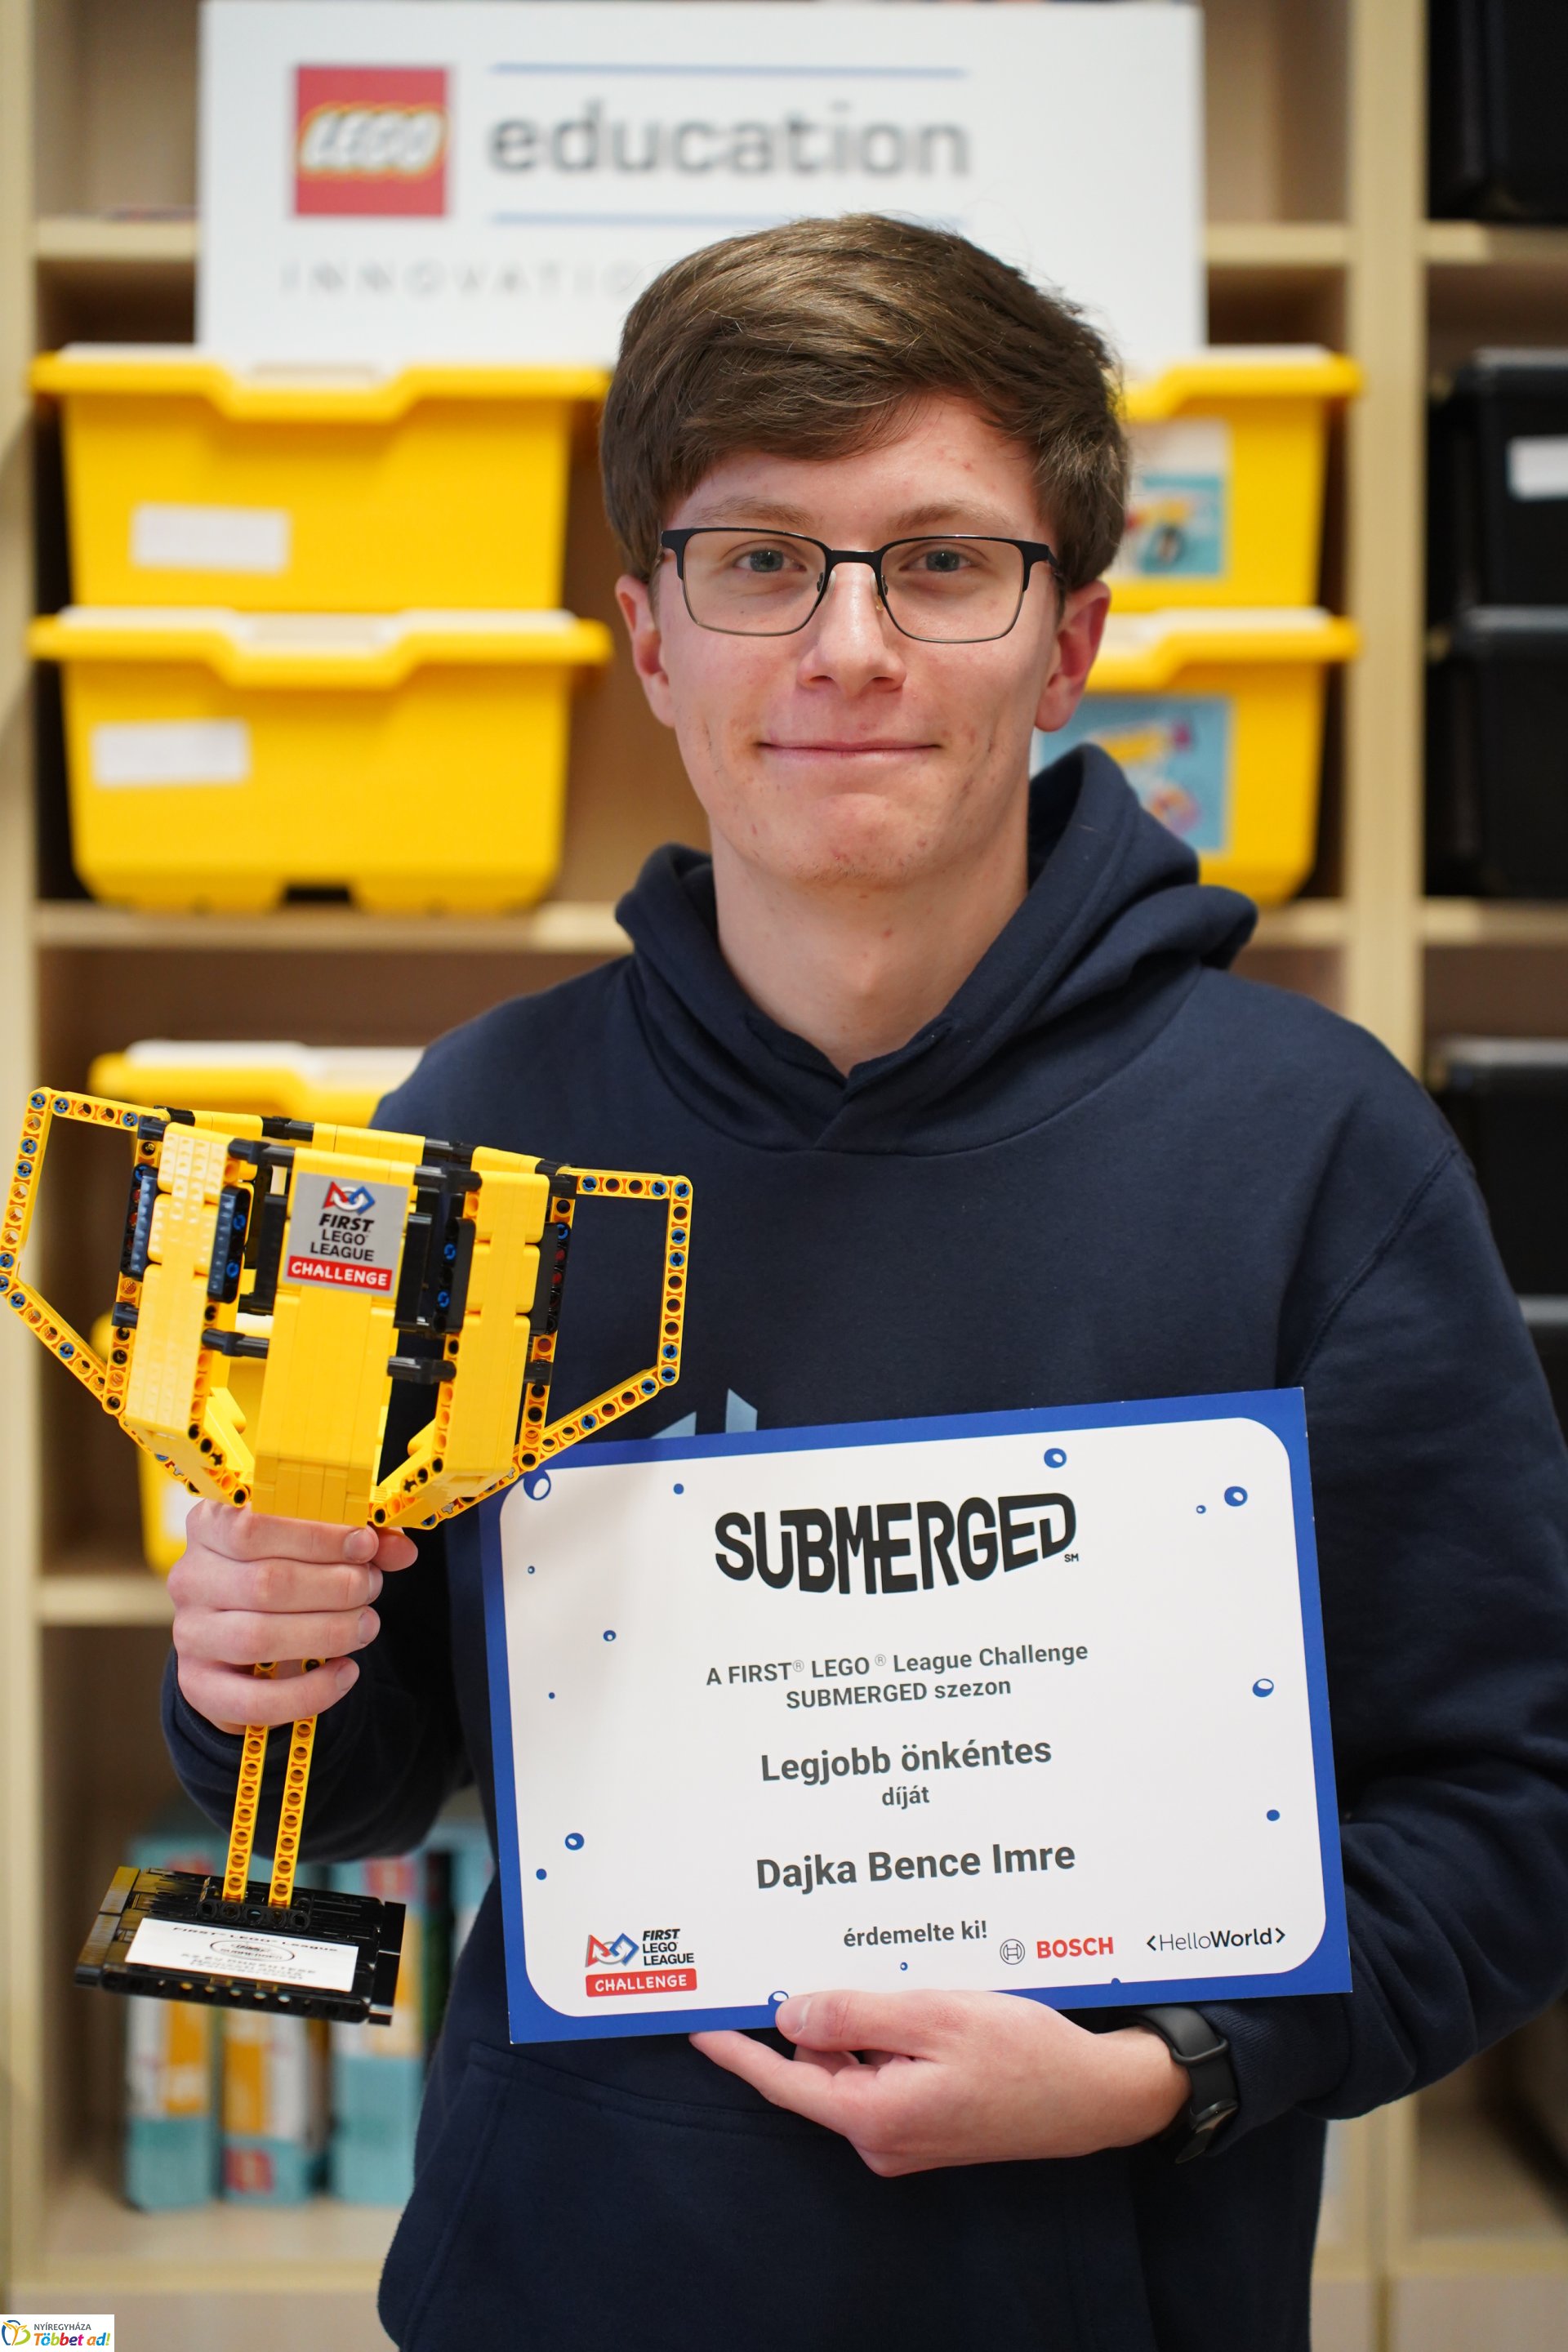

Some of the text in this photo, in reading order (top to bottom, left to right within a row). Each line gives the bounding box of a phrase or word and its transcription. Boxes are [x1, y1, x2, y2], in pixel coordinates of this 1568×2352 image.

[299, 99, 969, 180] LEGO education
[319, 1213, 374, 1232] FIRST
[322, 1229, 365, 1245] LEGO
[310, 1241, 375, 1262] LEAGUE
[291, 1261, 388, 1286] CHALLENGE
[715, 1493, 1076, 1594] SUBMERGED
[707, 1668, 721, 1685] A
[894, 1655, 971, 1674] League
[980, 1645, 1087, 1666] Challenge
[787, 1682, 1010, 1708] SUBMERGED szezon
[762, 1740, 1051, 1785] Legjobb önkéntes
[882, 1785, 929, 1809] díját
[757, 1844, 1075, 1895] Dajka Bence Imre
[642, 1928, 681, 1941] FIRST
[844, 1921, 987, 1947] érdemelte ki!
[643, 1942, 677, 1953] LEGO
[644, 1953, 694, 1966] LEAGUE
[1037, 1937, 1113, 1958] BOSCH
[595, 1975, 687, 1992] CHALLENGE
